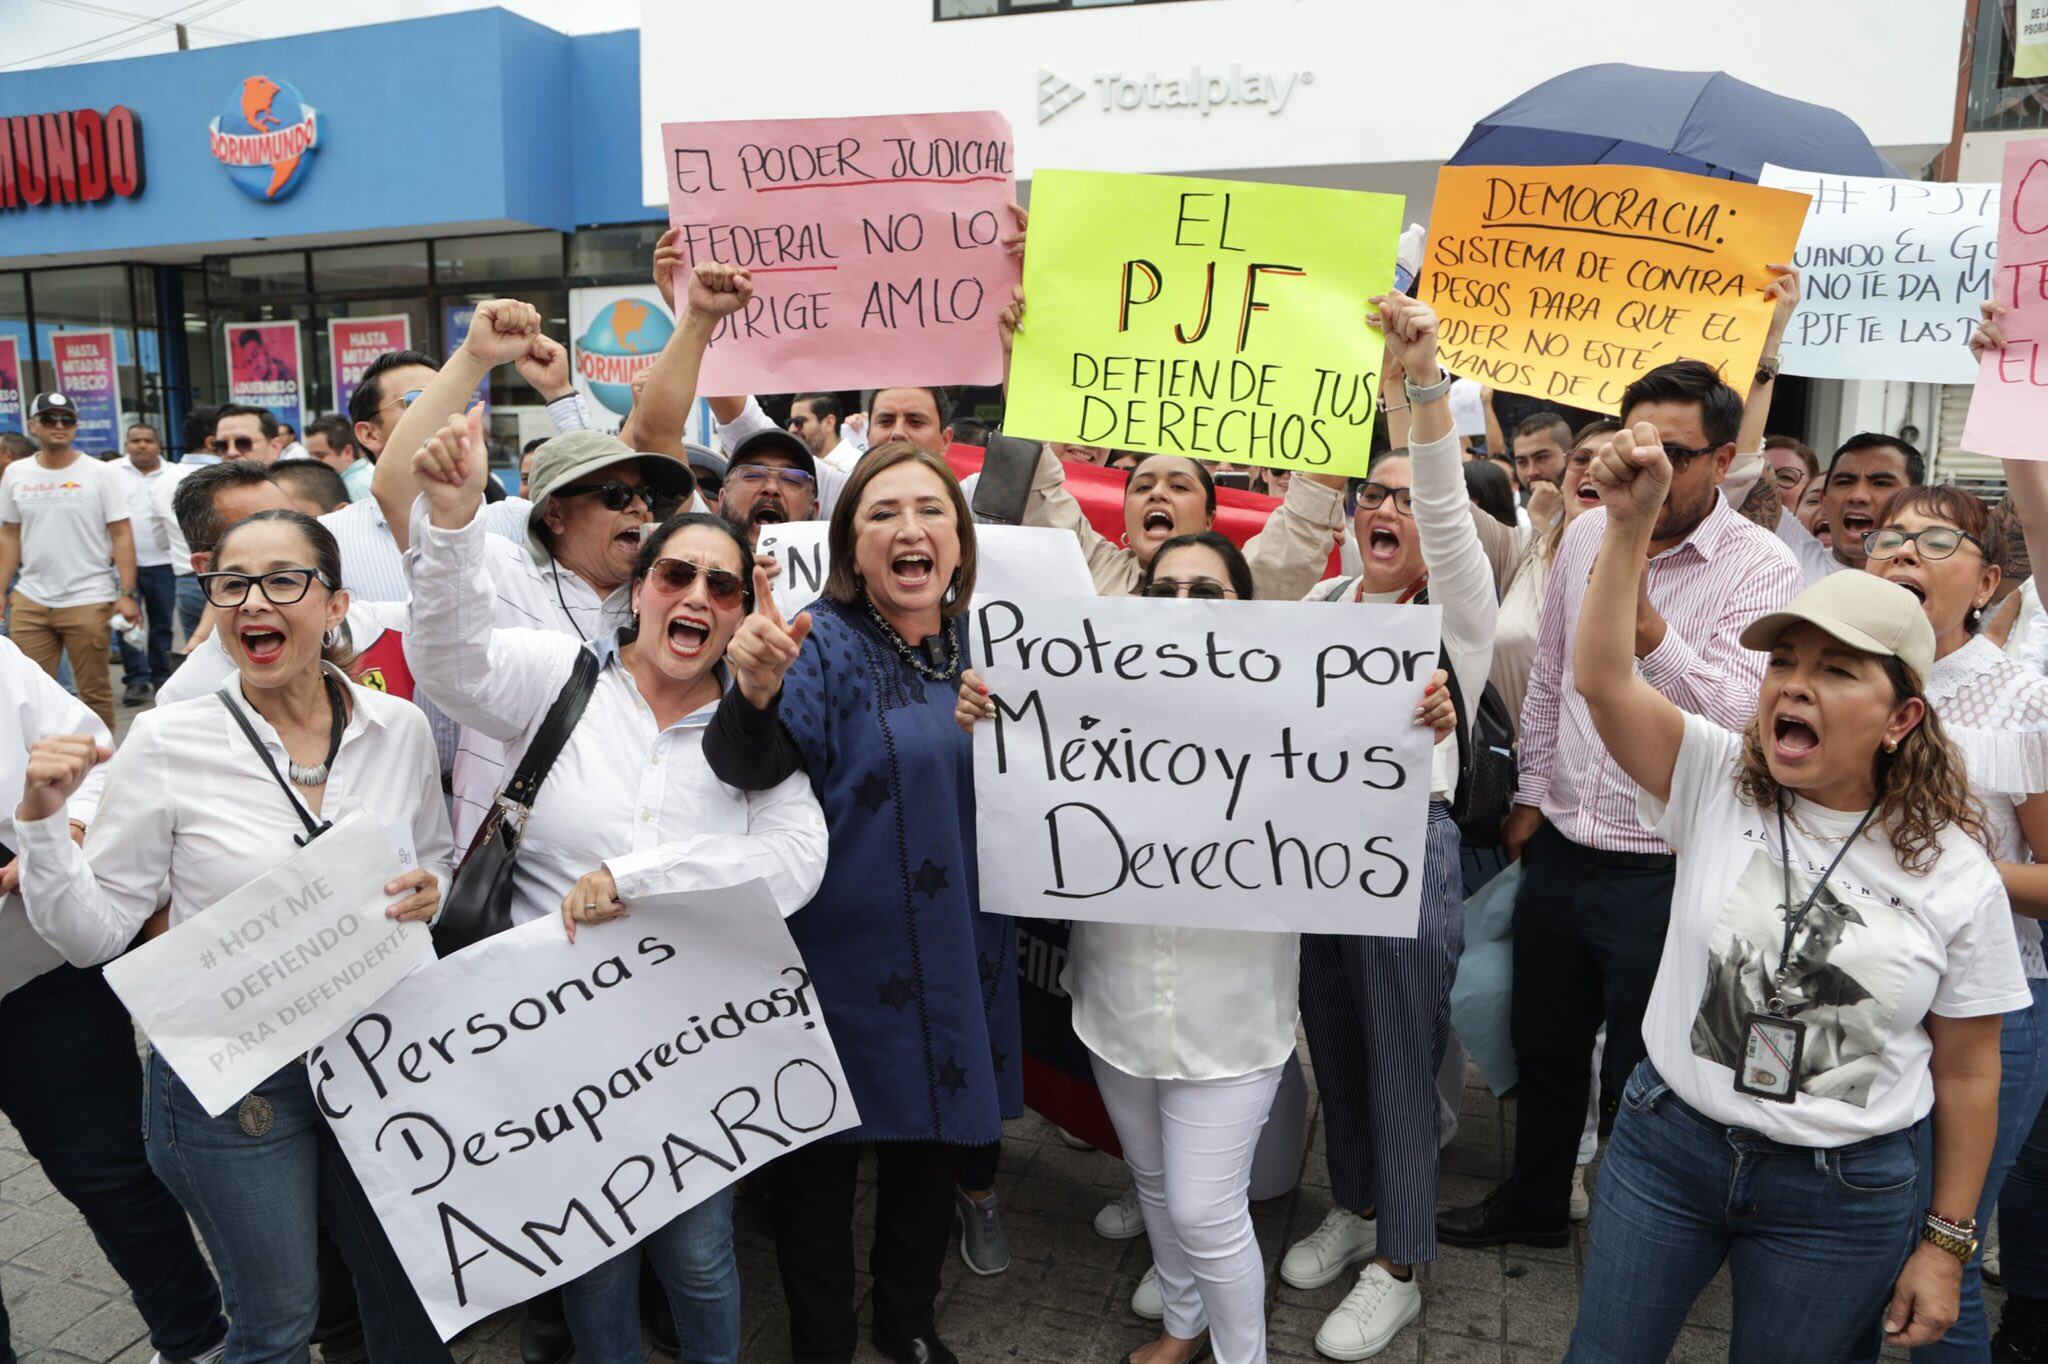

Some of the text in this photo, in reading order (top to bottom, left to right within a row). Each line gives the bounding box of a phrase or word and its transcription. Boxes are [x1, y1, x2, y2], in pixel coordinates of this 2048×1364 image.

[211, 118, 316, 165] DORMIMUNDO
[675, 138, 1012, 193] EL PODER JUDICIAL
[684, 210, 999, 268] FEDERAL NO LO
[1175, 193, 1246, 252] EL
[1434, 235, 1563, 273] SISTEMA
[1576, 251, 1617, 284] DE
[1793, 244, 1884, 268] UANDO
[861, 277, 984, 329] AMLO
[1118, 258, 1307, 353] PJF
[1432, 272, 1741, 343] PESOS PARA QUE EL
[1806, 273, 1851, 301] NO
[1856, 271, 1888, 298] TE
[1897, 273, 1941, 302] DA
[66, 344, 99, 357] HASTA
[349, 331, 388, 346] HASTA
[1437, 317, 1511, 353] ODER
[1524, 329, 1569, 358] NO
[1583, 340, 1663, 371] ESTÉ
[1797, 311, 1853, 346] PJF
[1857, 316, 1885, 344] TE
[1900, 319, 1951, 344] LAS
[64, 375, 108, 391] PRECIO
[1071, 353, 1376, 425] DEFIENDE TUS
[1436, 345, 1535, 388] MANOS
[1547, 370, 1593, 397] DE
[1076, 394, 1331, 465] DERECHOS
[978, 600, 1435, 708] Protesto por
[1270, 726, 1407, 790] tus
[1043, 802, 1410, 899] Derechos
[286, 876, 335, 914] ME
[220, 912, 360, 1011] DEFIENDO
[208, 924, 409, 1073] PARA DEFENDERTE
[375, 967, 812, 1195] Desaparecidas?
[436, 1058, 837, 1307] AMPARO
